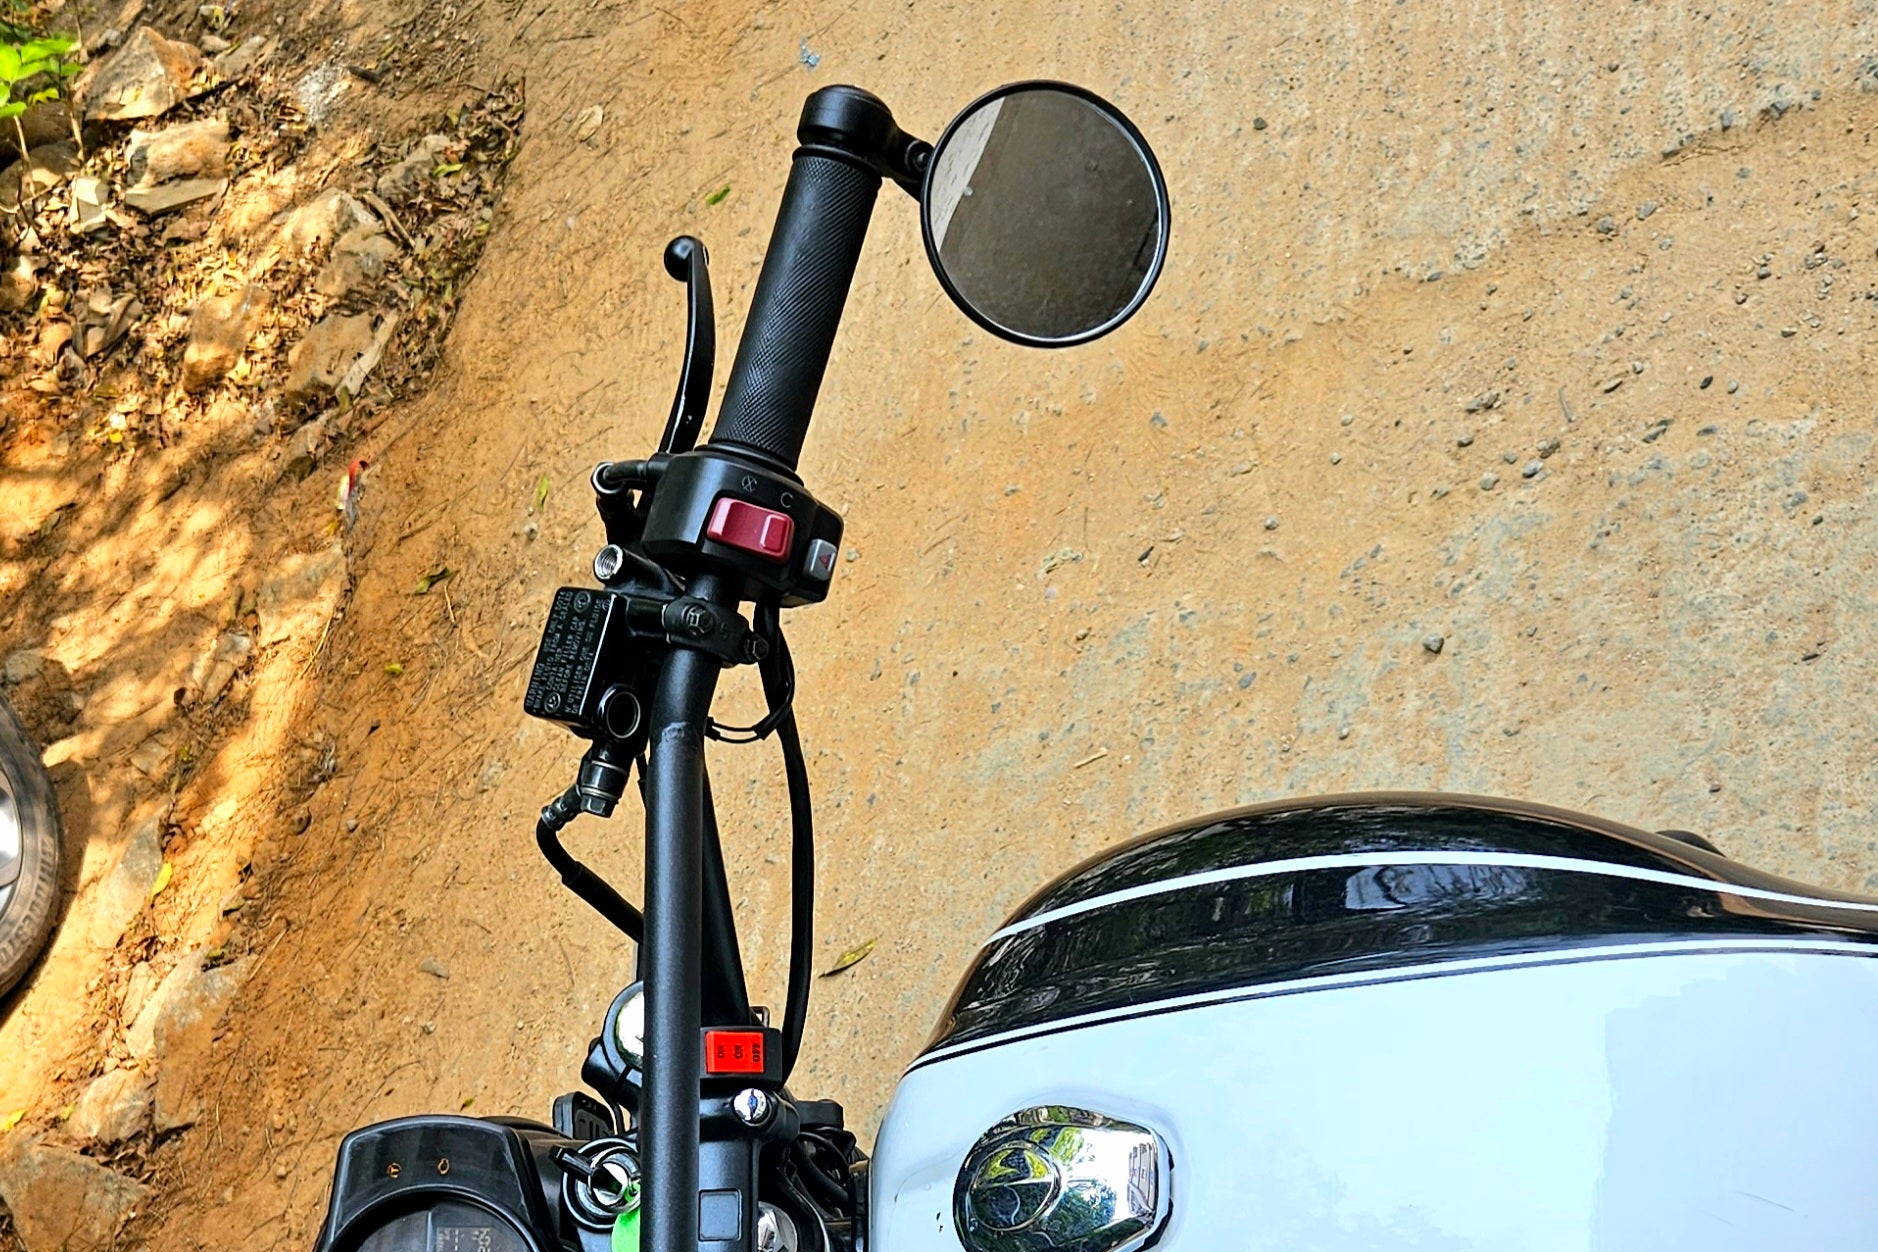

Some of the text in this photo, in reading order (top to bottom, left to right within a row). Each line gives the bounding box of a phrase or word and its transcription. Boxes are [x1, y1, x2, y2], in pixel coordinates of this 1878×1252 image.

[553, 616, 579, 691] CLEAN FILLER CAP
[542, 655, 553, 680] FLUID
[526, 662, 544, 706] WARNING
[734, 1045, 743, 1059] ON
[752, 1044, 760, 1062] OFF
